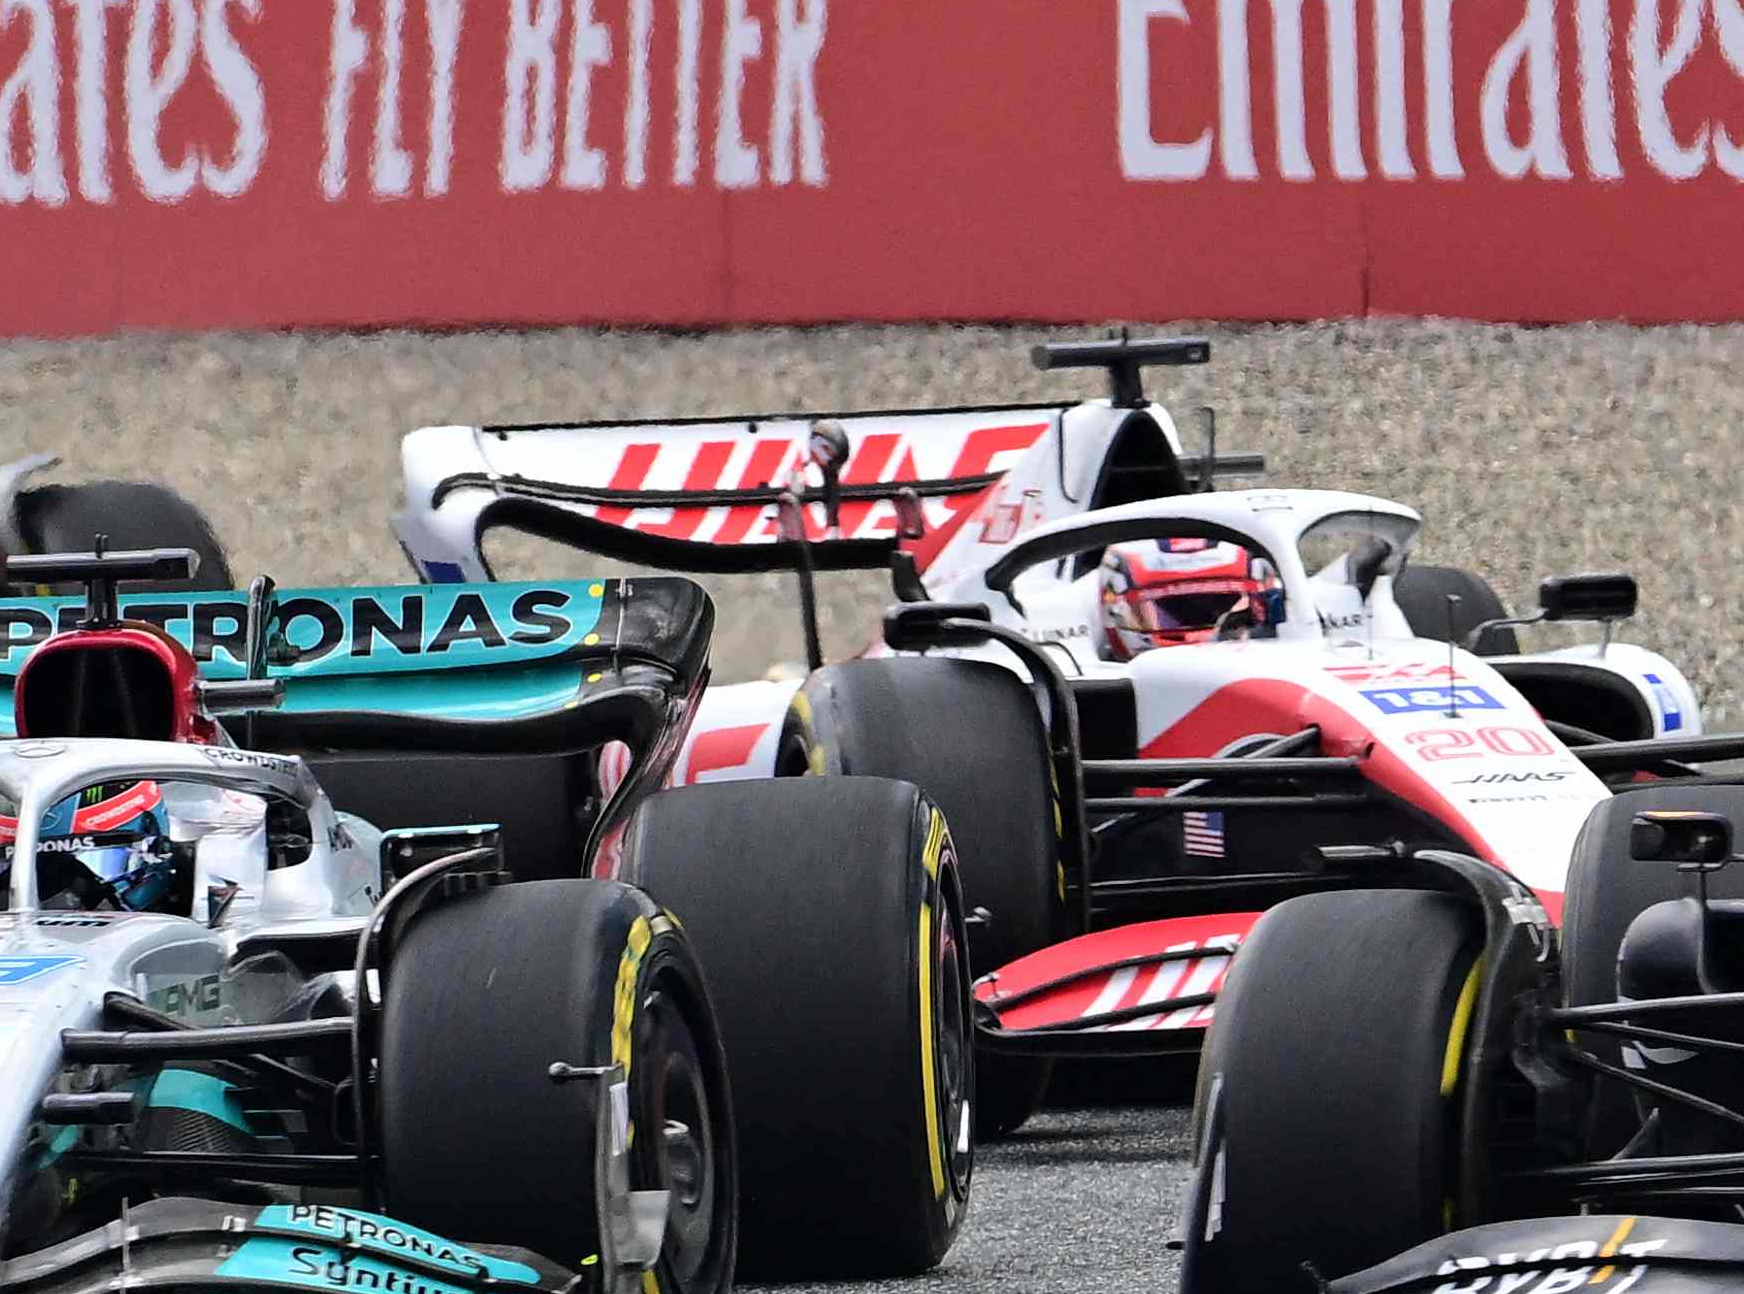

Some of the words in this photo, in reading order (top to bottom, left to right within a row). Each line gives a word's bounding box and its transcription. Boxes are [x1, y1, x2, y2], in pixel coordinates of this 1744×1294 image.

[1406, 727, 1555, 762] 20
[1452, 771, 1576, 784] HAAS
[285, 1205, 483, 1275] PETRONAS
